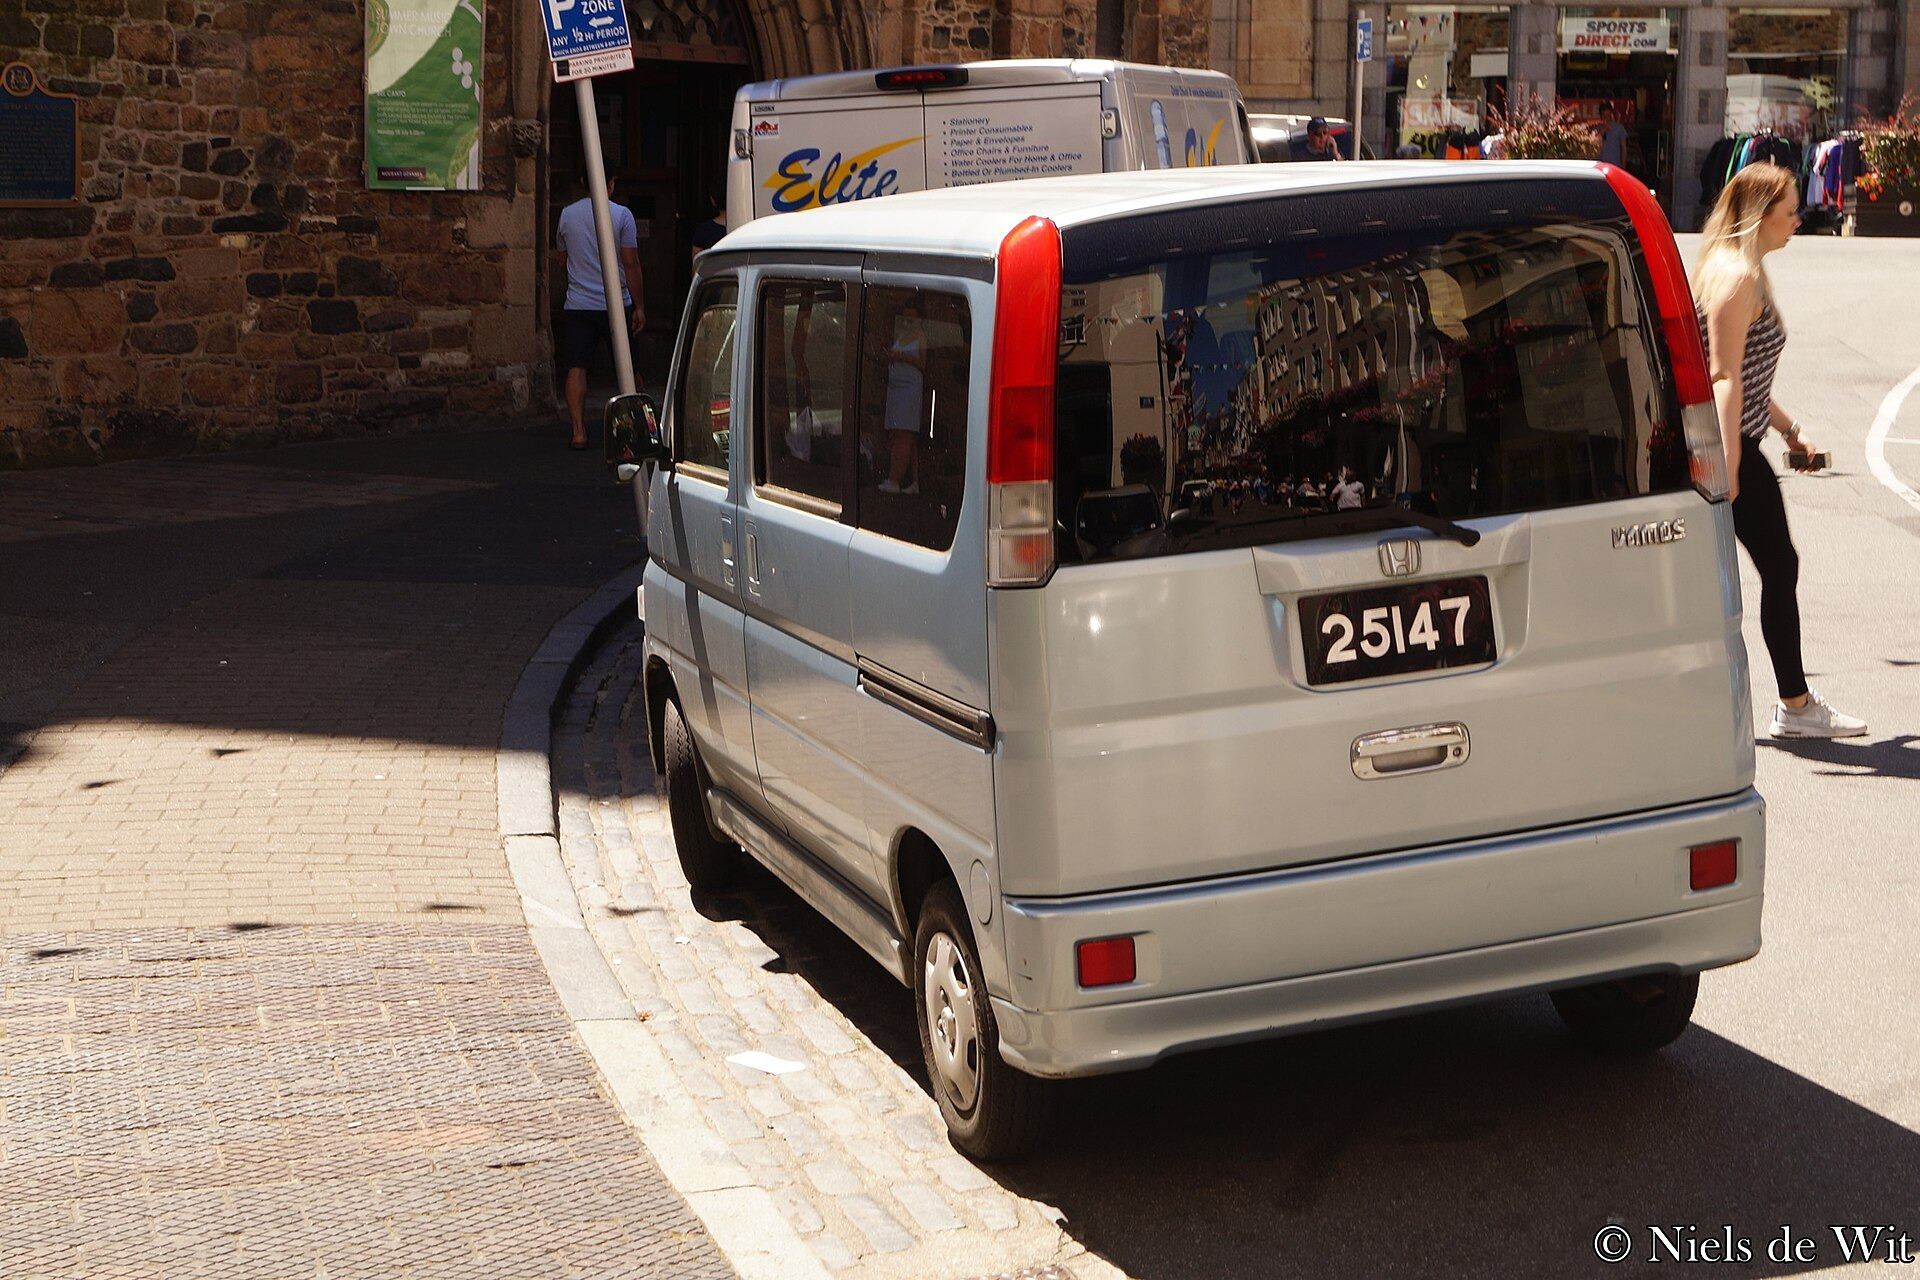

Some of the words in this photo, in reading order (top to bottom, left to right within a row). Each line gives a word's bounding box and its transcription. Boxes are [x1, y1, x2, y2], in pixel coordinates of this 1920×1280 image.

[549, 0, 576, 30] P
[581, 0, 616, 15] ZONE
[1585, 20, 1648, 33] SPORTS
[552, 36, 569, 47] ANY
[595, 26, 625, 40] PERIOD
[592, 63, 617, 72] MINUTES
[950, 117, 990, 127] Stationery
[950, 127, 977, 137] Printer
[979, 124, 1033, 135] Consumables
[950, 138, 973, 148] Paper
[984, 134, 1025, 145] Envelopes
[951, 148, 974, 158] Office
[976, 146, 1002, 156] Chairs
[1004, 145, 1010, 153] &
[1012, 144, 1049, 153] Furniture
[951, 158, 973, 168] Water
[976, 156, 1007, 166] Coolers
[1008, 156, 1022, 164] For
[1024, 154, 1048, 163] Home
[1058, 152, 1082, 161] Office
[951, 168, 980, 178] Bottled
[982, 168, 992, 176] Or
[993, 164, 1039, 176] Plumbed-In
[1041, 163, 1073, 173] Coolers
[772, 148, 899, 212] Elite
[1321, 595, 1471, 665] 25147
